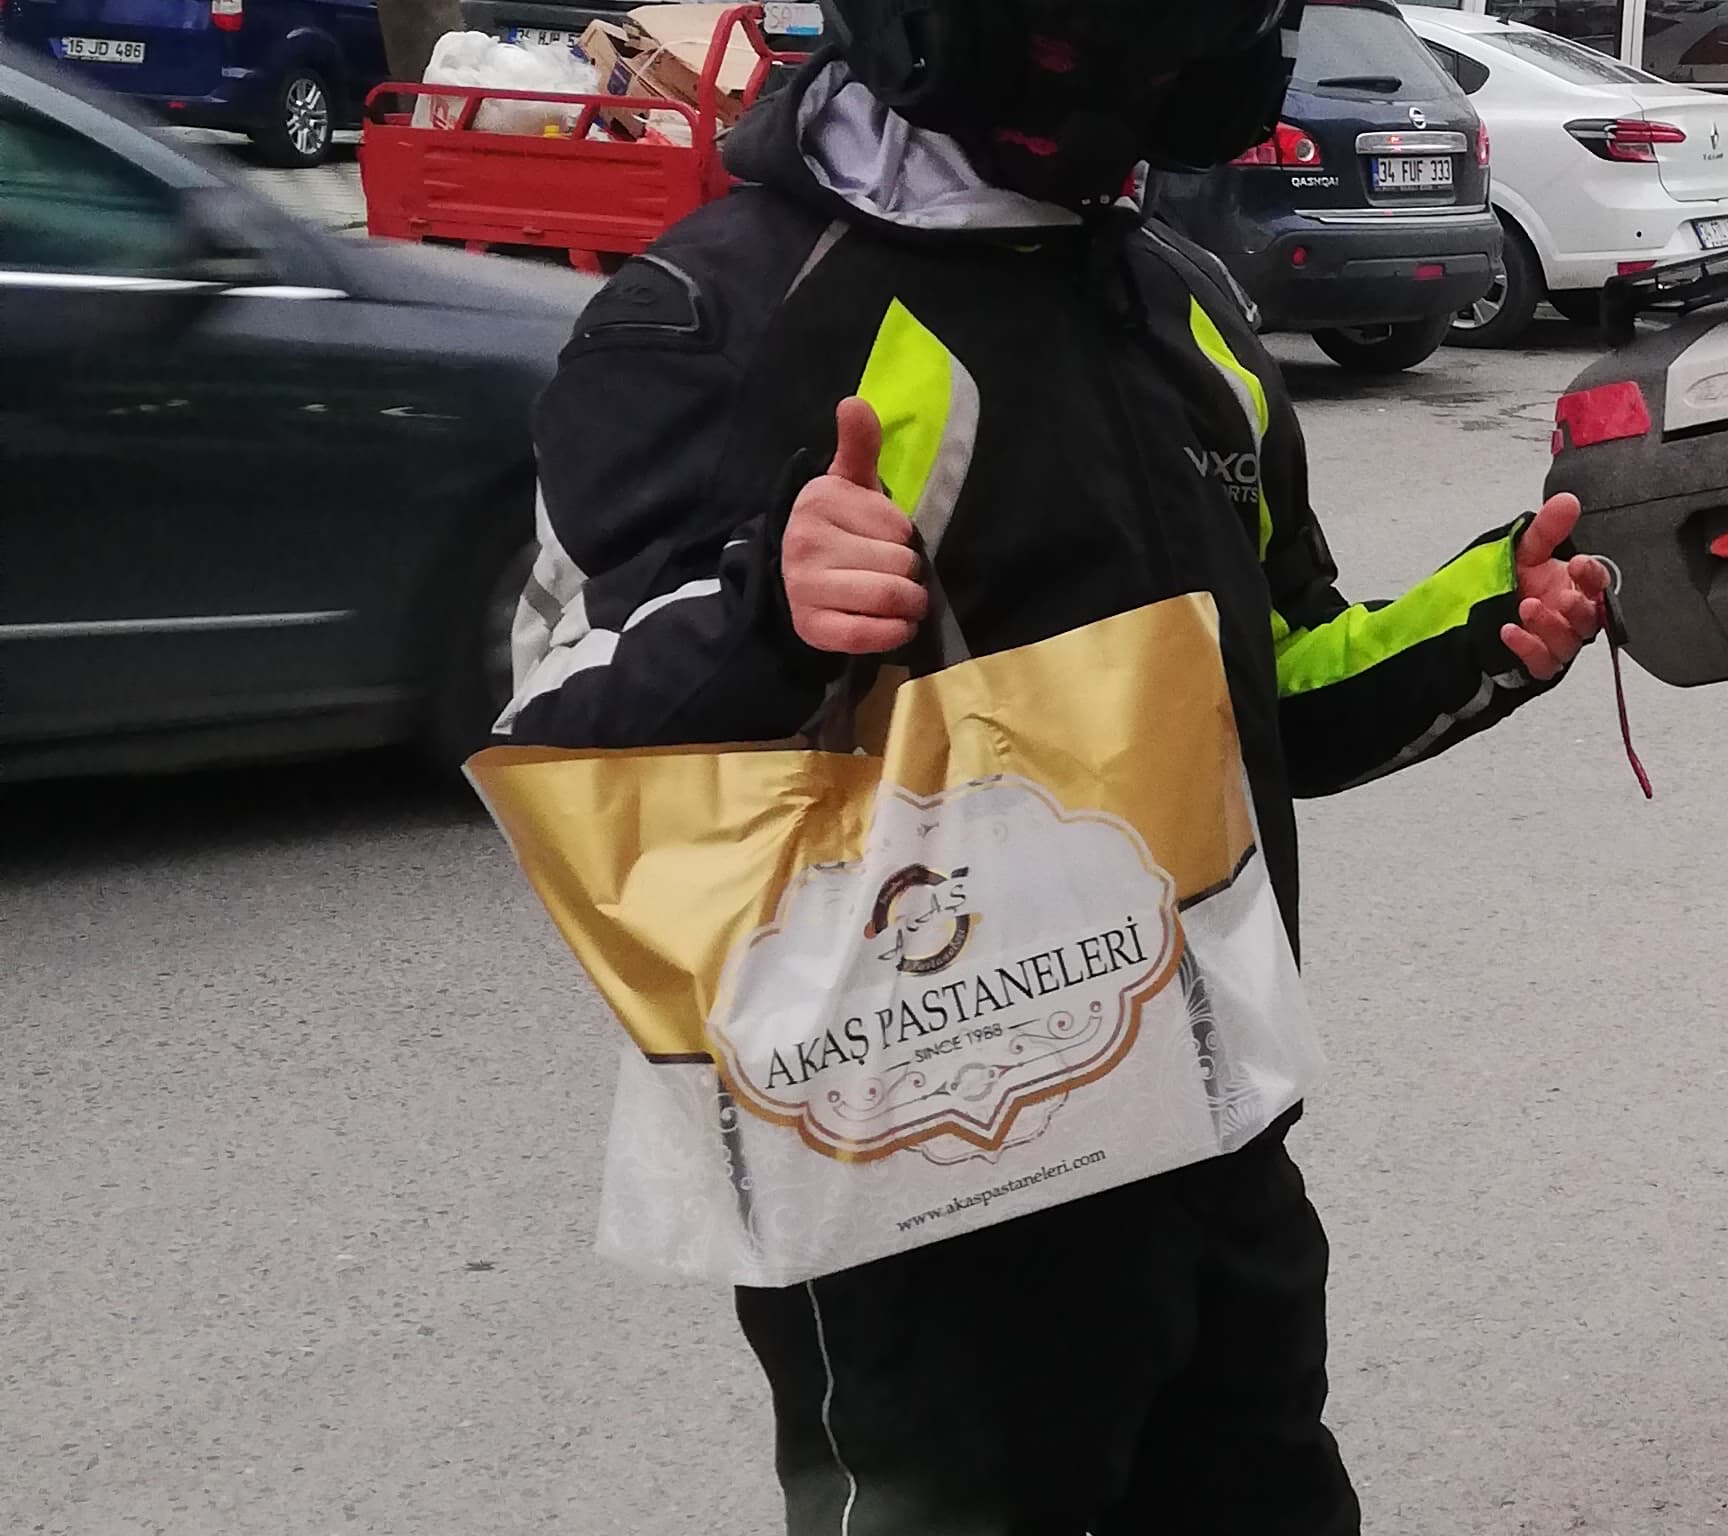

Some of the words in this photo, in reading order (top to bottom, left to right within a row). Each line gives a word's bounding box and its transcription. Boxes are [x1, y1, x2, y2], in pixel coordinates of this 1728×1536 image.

[68, 38, 84, 54] 15
[88, 41, 109, 56] JD
[115, 42, 142, 59] 486
[1291, 176, 1340, 188] QASHQAI
[1380, 161, 1395, 183] 34
[1402, 160, 1423, 183] FUF
[1430, 159, 1450, 182] 333
[765, 1016, 871, 1091] AKAŞ
[877, 915, 1150, 1051] PASTANELERİ
[914, 1036, 964, 1064] SINCE
[896, 1148, 1107, 1233] www.akaspastaneleri.com
